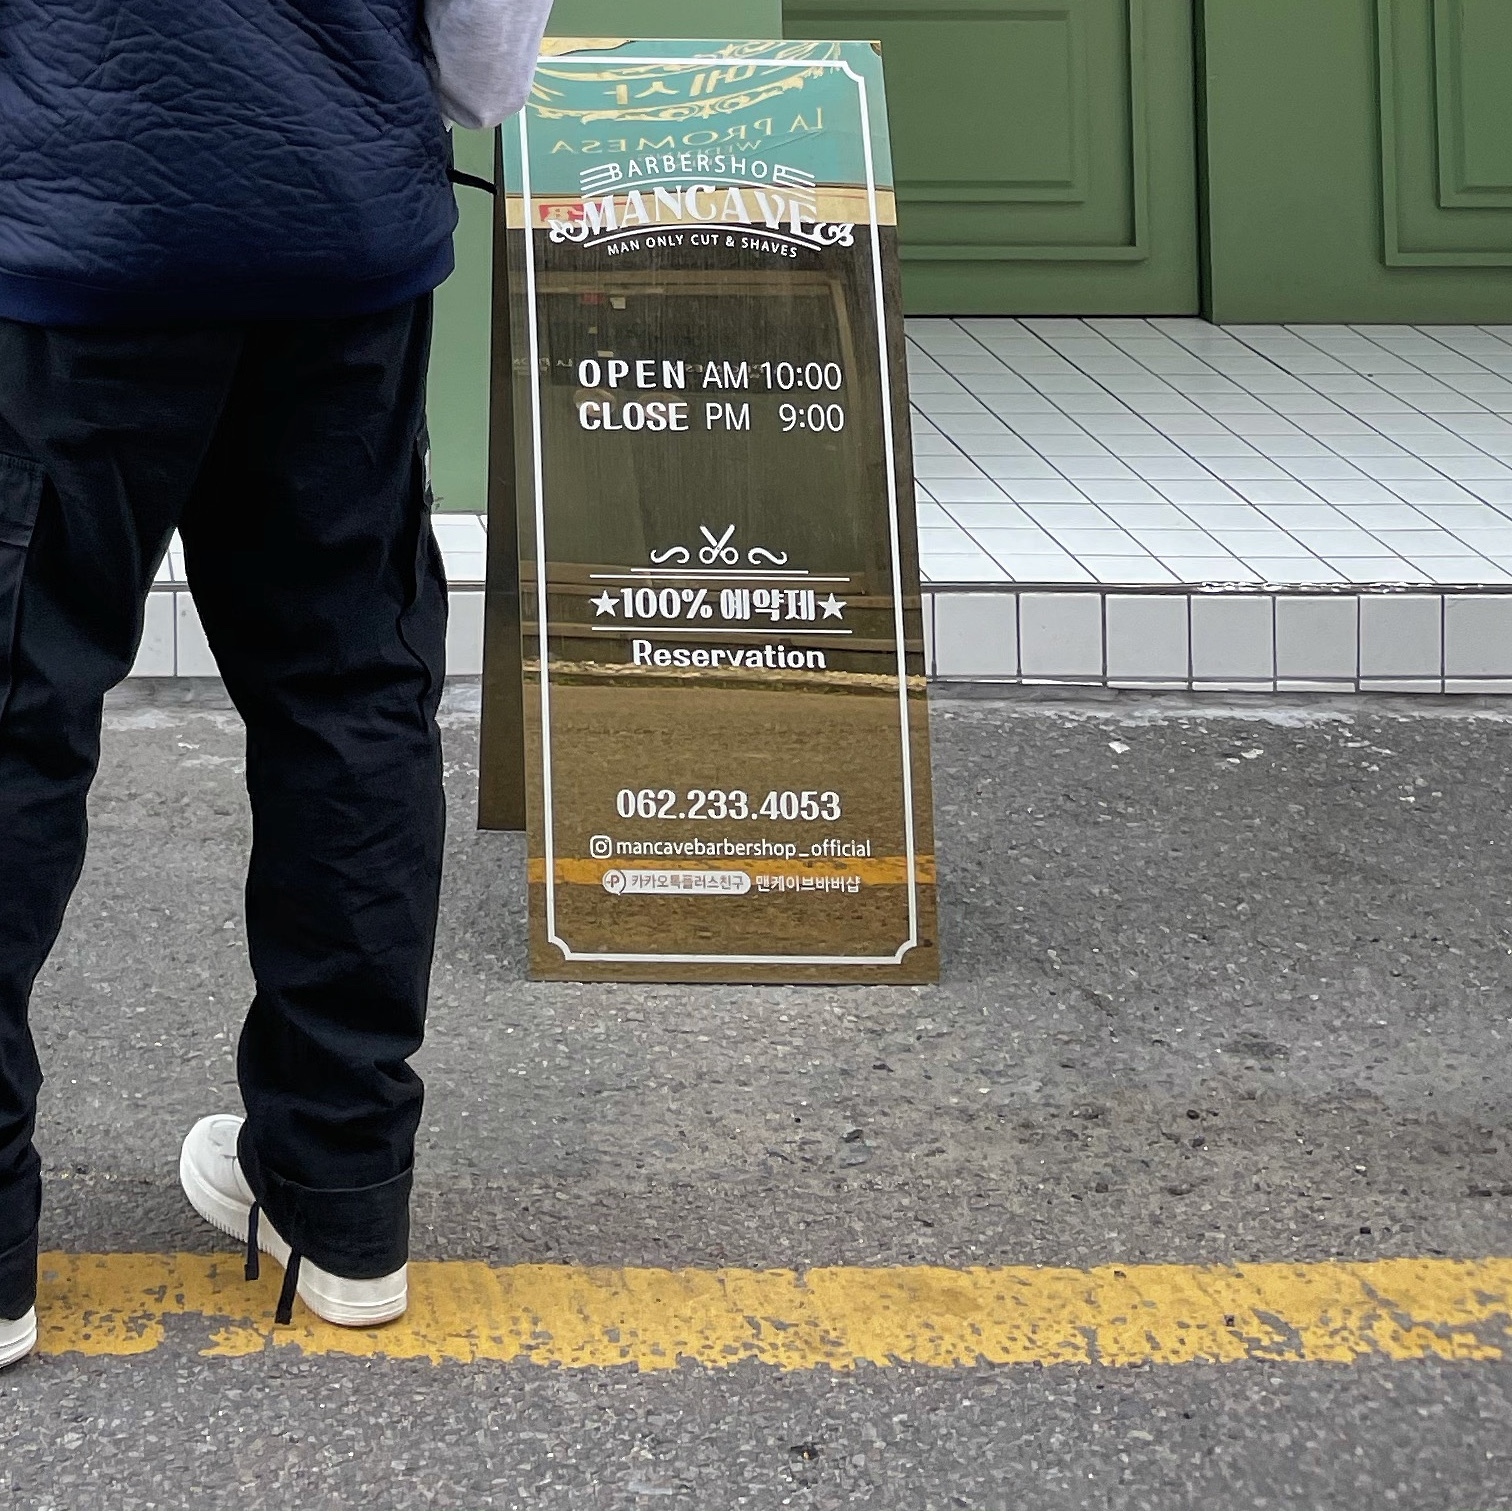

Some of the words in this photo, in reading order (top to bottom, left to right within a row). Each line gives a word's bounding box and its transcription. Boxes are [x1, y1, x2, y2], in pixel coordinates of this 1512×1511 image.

[609, 154, 786, 182] BARBERSHOP
[581, 185, 818, 239] MANCAVE
[607, 240, 640, 256] MAN
[645, 234, 684, 248] ONLY
[690, 234, 719, 246] CUT
[725, 235, 735, 247] &
[741, 237, 798, 258] SHAVES
[578, 359, 686, 389] OPEN
[702, 361, 748, 389] AM
[760, 361, 842, 390] 10:00
[579, 401, 689, 431] CLOSE
[705, 402, 750, 430] PM
[779, 403, 845, 432] 9:00
[620, 588, 713, 619] 100%
[720, 588, 816, 621] 예약제
[632, 639, 827, 670] Reservation
[616, 789, 841, 821] 062.233.4053
[616, 838, 871, 859] mancavebarbershop_official
[756, 874, 861, 892] 맨케이브바버샵
